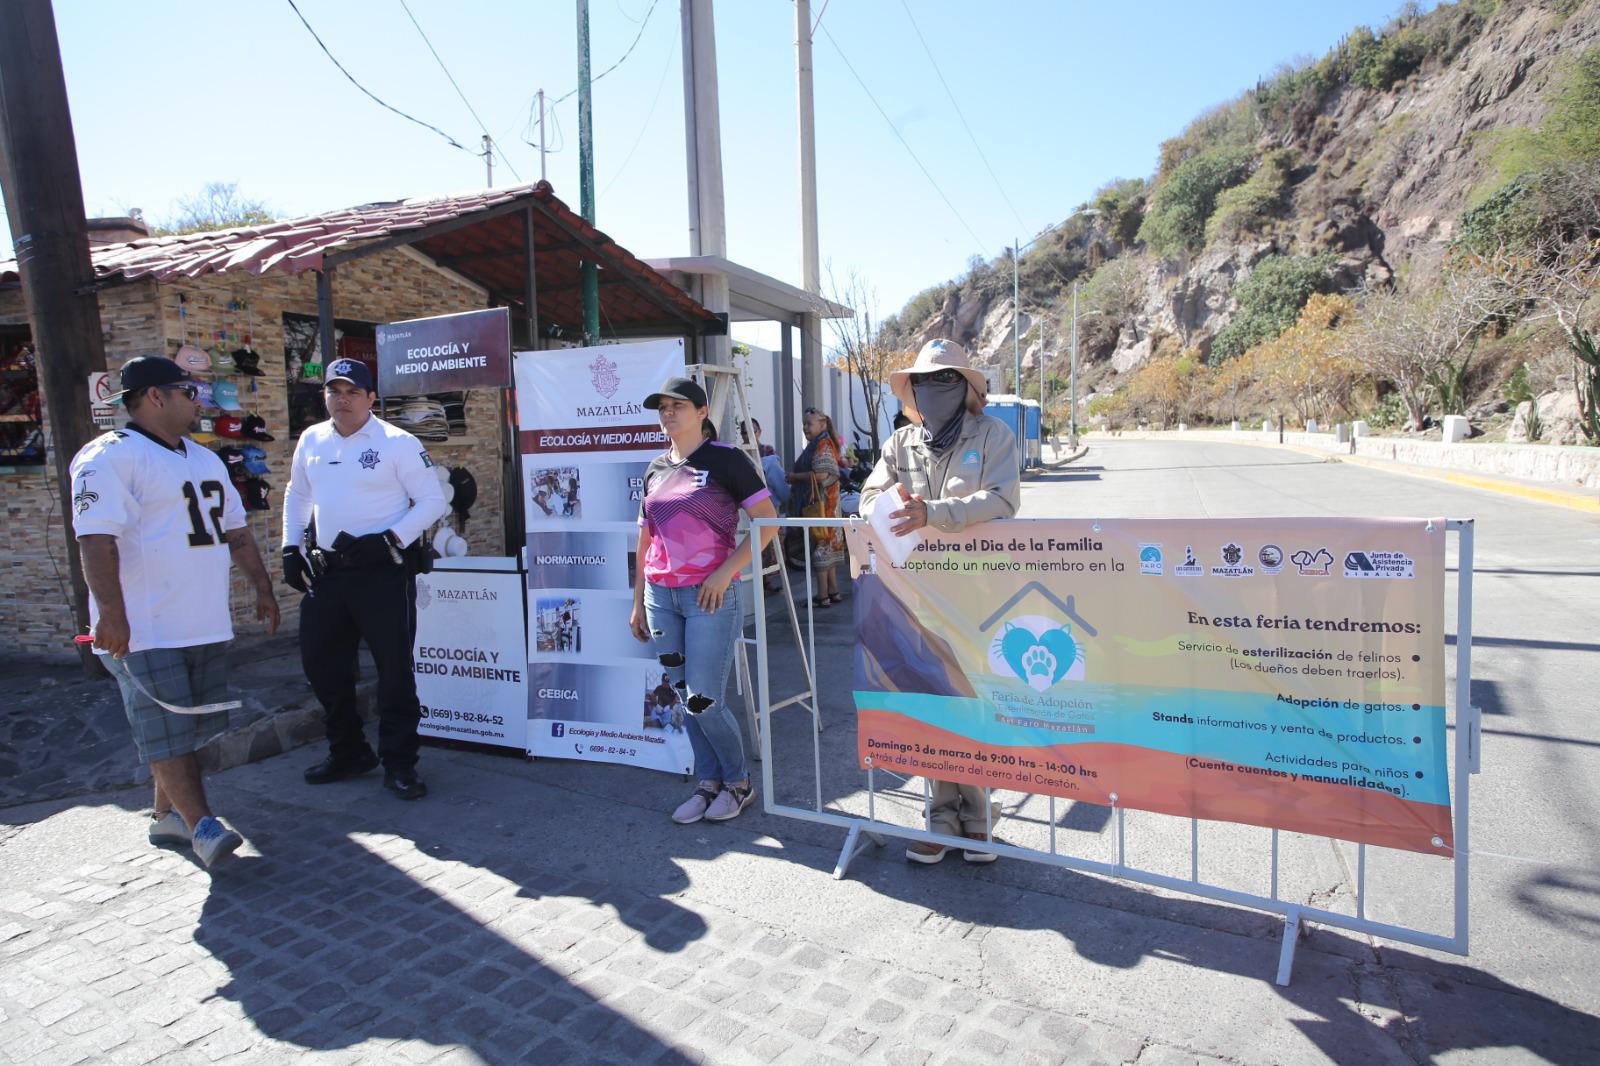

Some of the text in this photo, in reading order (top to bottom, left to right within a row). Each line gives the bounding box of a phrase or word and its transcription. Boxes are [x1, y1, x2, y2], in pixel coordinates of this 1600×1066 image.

[407, 342, 470, 359] ECOLOGÍA Y
[395, 356, 487, 375] MEDIO AMBIENTE
[577, 401, 642, 417] MAZATLÁN
[540, 431, 670, 447] ECOLOGÍA Y MEDIO AMBIEN
[182, 480, 228, 546] 12
[912, 538, 961, 552] elebra
[964, 538, 977, 552] el
[1008, 538, 1025, 551] de
[1029, 538, 1044, 551] la
[1047, 537, 1103, 551] Familia
[536, 555, 607, 565] NORMATIVIDAD
[963, 561, 978, 571] un
[982, 561, 1021, 572] nuevo
[1025, 558, 1084, 572] miembro
[1089, 561, 1107, 572] en
[1111, 557, 1125, 572] la
[1372, 558, 1413, 566] Asistencia
[1375, 564, 1405, 572] Privada
[1212, 566, 1254, 574] MAZATLÁN
[437, 588, 497, 601] MAZATLÁN
[1187, 611, 1421, 634] En esta feria tendremos:
[419, 646, 500, 664] ECOLOGÍA Y
[1178, 640, 1402, 663] Servicio de esterilización de felinos
[451, 665, 521, 683] AMBIENTE
[1230, 657, 1405, 682] (Los dueños deben traerlos).
[538, 688, 579, 700] CEBICA
[1037, 696, 1093, 710] Adopción
[1277, 693, 1405, 714] Adopción de gatos.
[430, 708, 504, 726] (669) 9-82-84-52
[600, 730, 618, 738] Medio
[1152, 711, 1406, 745] Stands informativos y venta de productos.
[868, 738, 913, 753] Domingo
[914, 743, 920, 753] 3
[922, 744, 936, 756] de
[939, 747, 972, 760] marzo
[974, 750, 988, 762] de
[990, 753, 1015, 765] 9:00
[1019, 756, 1036, 769] hrs
[1046, 762, 1076, 775] 14:00
[1079, 765, 1098, 778] hrs
[1265, 752, 1409, 779] Actividades para niños
[870, 751, 1080, 791] Atrás de la escollera del cerro del Crestón.
[1185, 757, 1410, 798] (Cuenta cuentos y manualidades).
